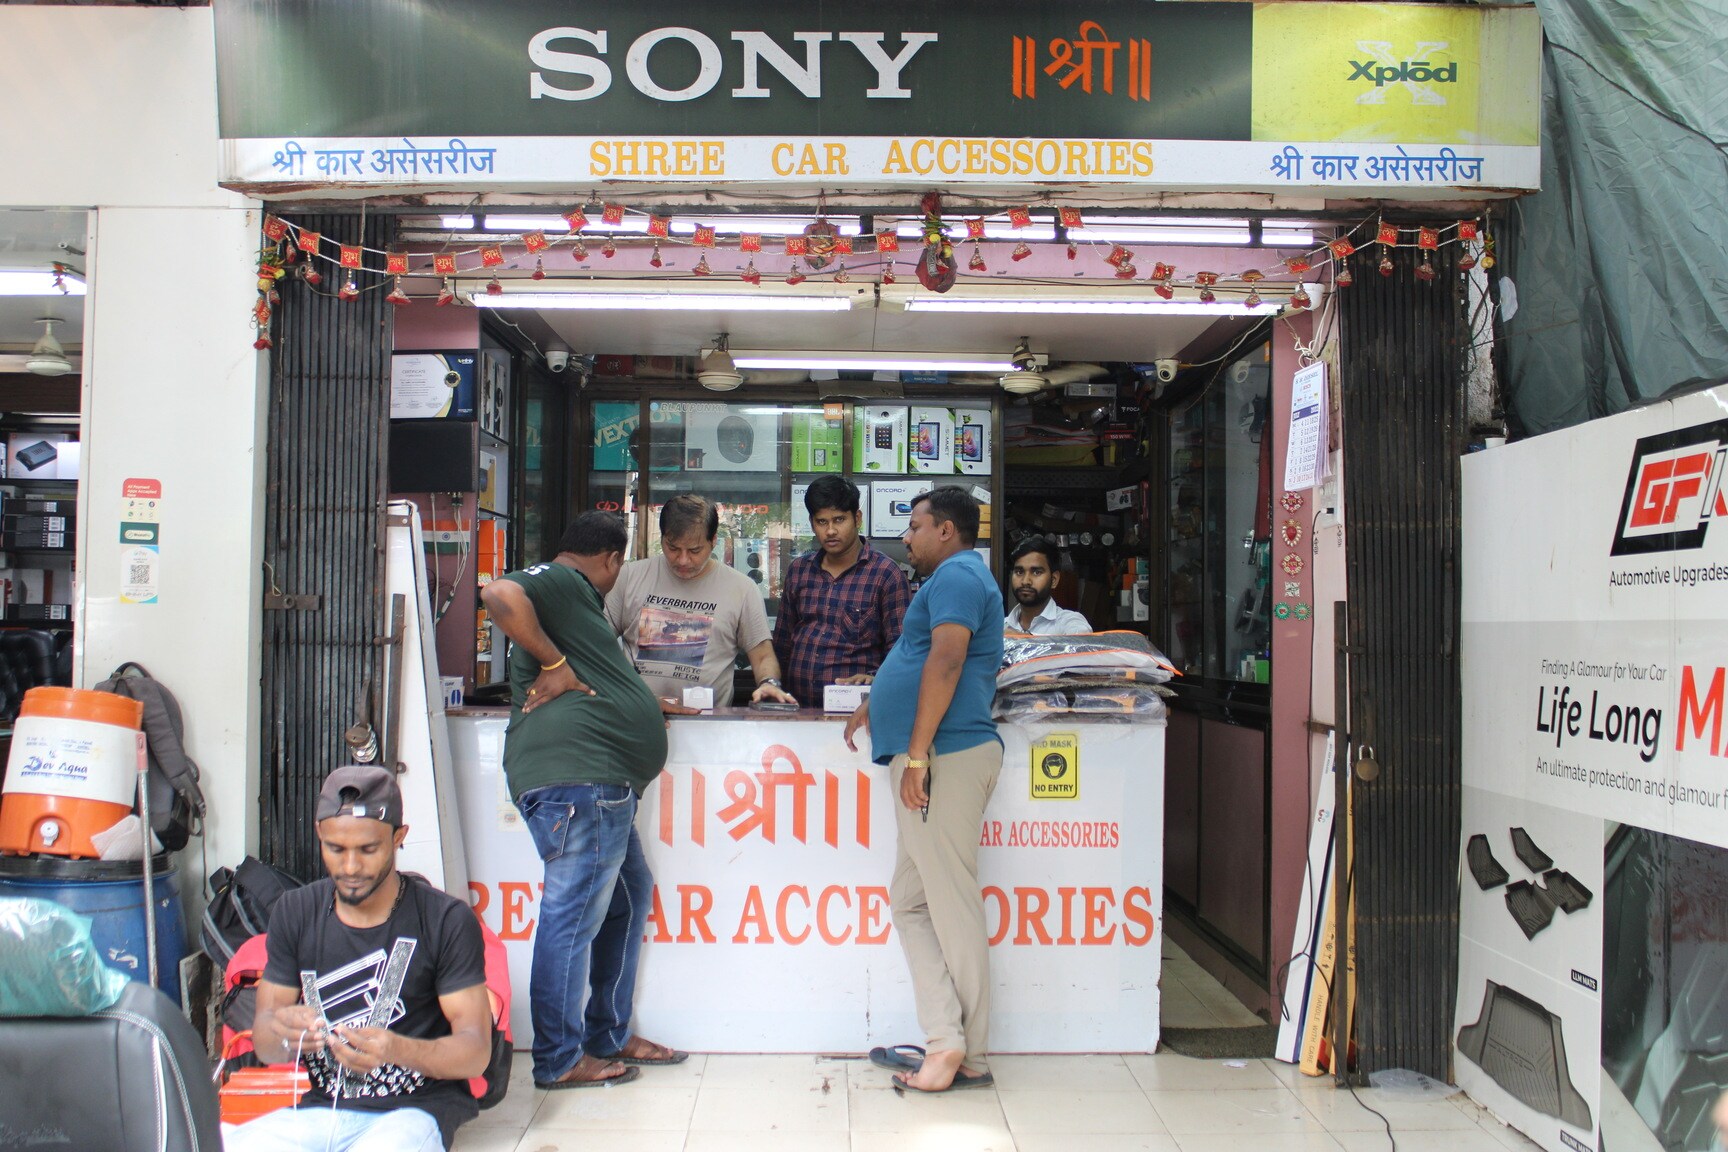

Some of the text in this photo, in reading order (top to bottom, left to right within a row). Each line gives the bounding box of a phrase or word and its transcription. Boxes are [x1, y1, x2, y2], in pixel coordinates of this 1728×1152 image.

[528, 27, 939, 101] SONY
[272, 138, 497, 176] श्री कार असेसरीज
[589, 139, 1154, 178] SHREE CAR ACCESSORIES
[1269, 145, 1485, 182] श्री कार असेसरीज
[660, 402, 727, 413] BLAUPUNKT
[1609, 563, 1728, 587] Automotive Upgrades
[1541, 659, 1667, 682] Finding A Glamour for Your Car
[1537, 665, 1728, 763] Life Long M
[1050, 739, 1072, 748] MASK
[23, 755, 88, 774] Dev Aqua
[1035, 784, 1074, 792] NO ENTRY
[1536, 756, 1548, 775] An
[1549, 759, 1587, 783] ultimate
[1589, 769, 1642, 794] protection
[1644, 778, 1666, 798] and
[1668, 780, 1720, 808] glamour
[979, 820, 1120, 849] AR ACCESSORIES
